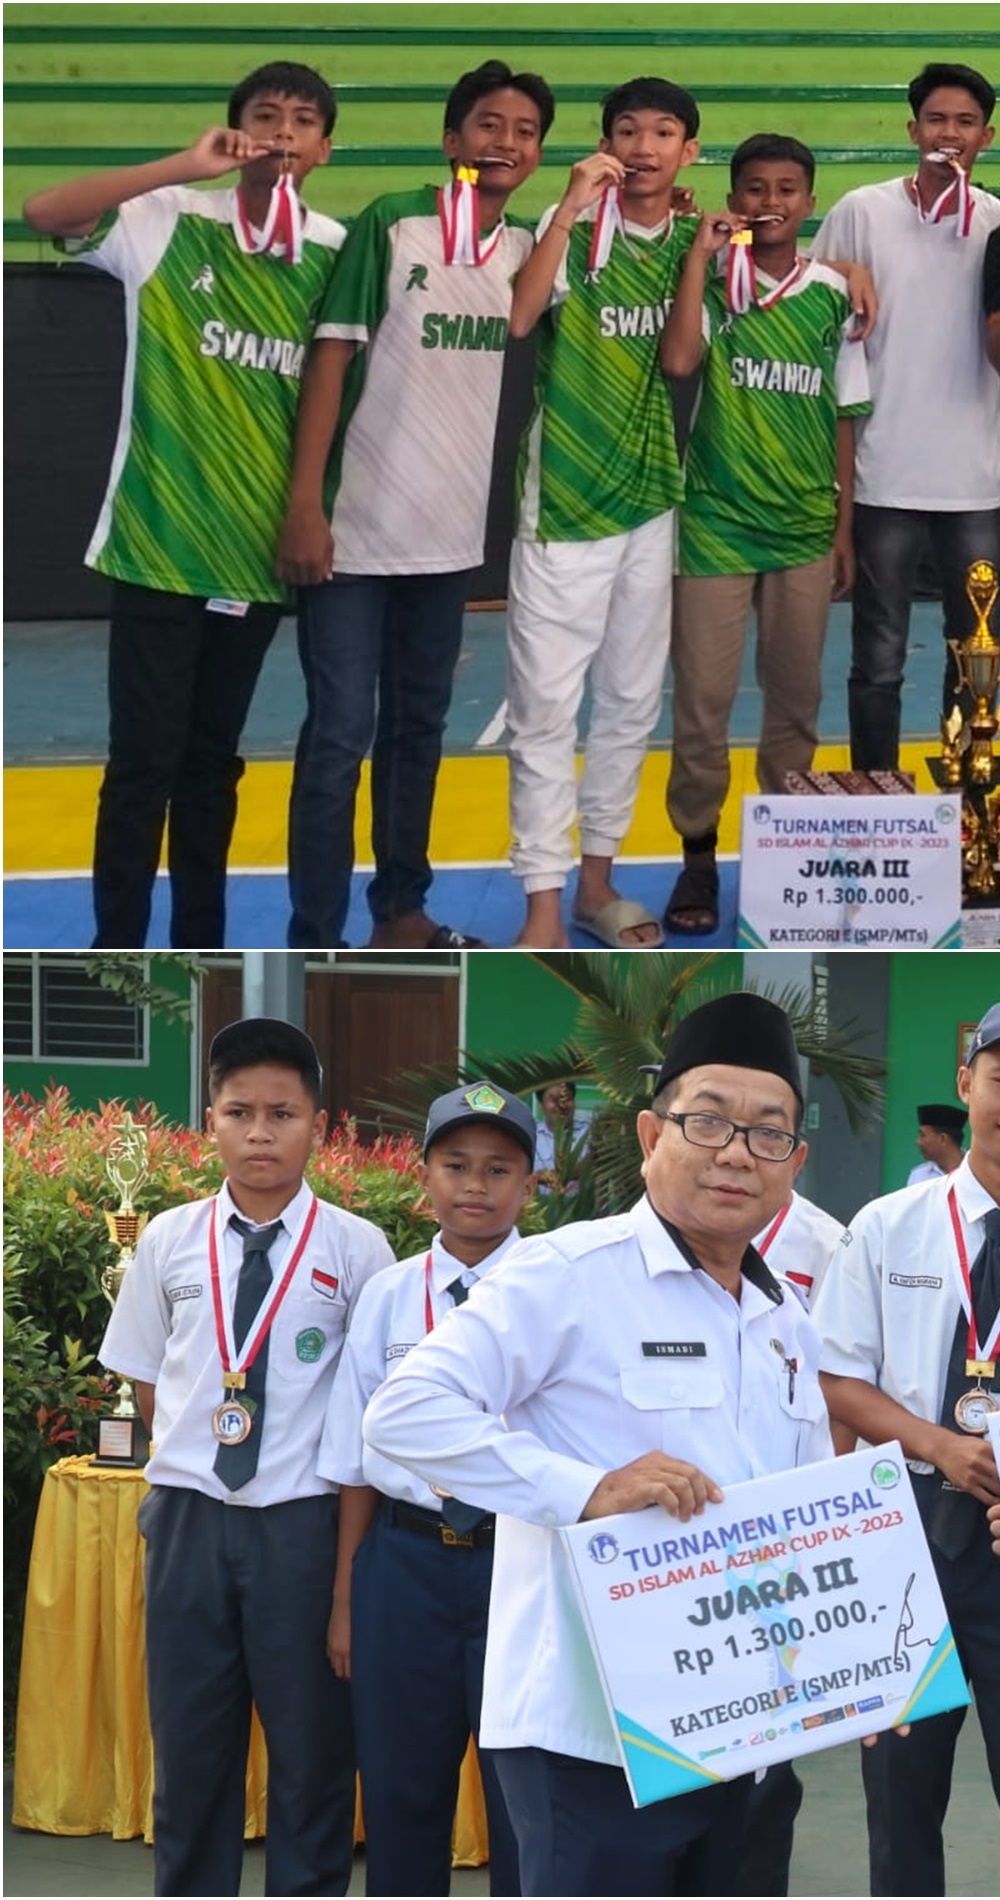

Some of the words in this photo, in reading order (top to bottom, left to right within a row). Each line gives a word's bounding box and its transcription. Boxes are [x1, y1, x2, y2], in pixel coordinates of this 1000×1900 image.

[420, 313, 509, 352] SWAND
[730, 357, 823, 397] SWANDA
[773, 819, 869, 834] TURNAMEN
[874, 819, 938, 834] FUTSAL
[776, 838, 808, 848] ISLAM
[873, 838, 898, 848] CUP
[799, 860, 876, 878] JUARA
[882, 860, 910, 877] III
[783, 888, 808, 908] Rp
[816, 888, 923, 906] 1.300.000,-
[770, 929, 841, 942] KATEGORI
[854, 928, 928, 944] (SMP/MTs)
[623, 1514, 778, 1572] TURNAMEN
[783, 1488, 883, 1532] FUTSAL
[609, 1582, 636, 1600] SD
[638, 1566, 696, 1594] ISLAM
[699, 1559, 722, 1578] AL
[726, 1544, 787, 1572] AZHAR
[790, 1531, 829, 1554] CUP
[832, 1523, 852, 1541] IX
[687, 1572, 810, 1627] JUARA
[813, 1557, 858, 1591] III
[673, 1648, 714, 1676] Rp
[724, 1600, 888, 1662] 1.300.000,-
[670, 1689, 785, 1738] KATEGORI
[785, 1684, 798, 1705] E
[802, 1651, 911, 1701] (SMP/MTs)
